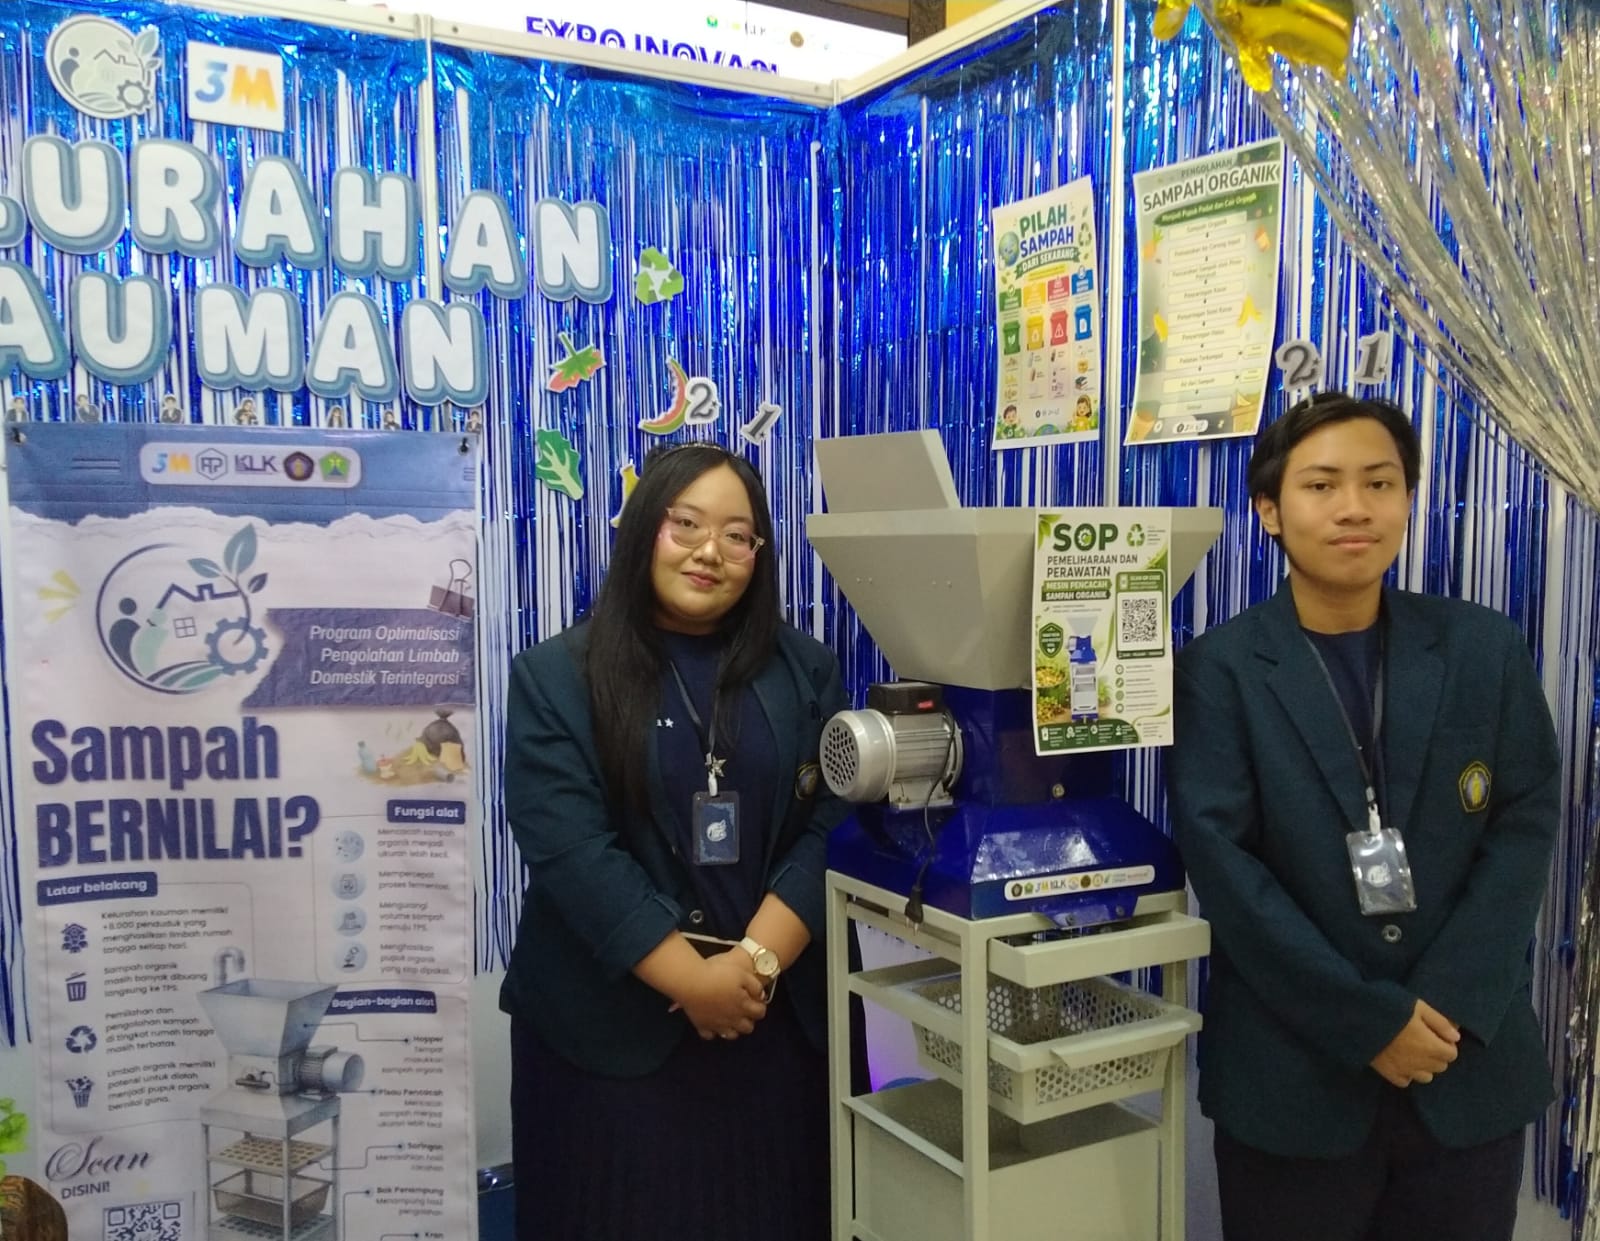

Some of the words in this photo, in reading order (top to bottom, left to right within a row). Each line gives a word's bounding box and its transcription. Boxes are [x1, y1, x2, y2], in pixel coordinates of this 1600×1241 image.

[194, 60, 278, 113] 3M
[1143, 179, 1204, 212] SAMPAH
[1208, 164, 1278, 192] ORGANIK
[0, 135, 613, 304] URAHAN
[1020, 203, 1067, 239] PILAH
[1020, 225, 1075, 258] SAMPAH
[1022, 257, 1039, 271] DARI
[1040, 248, 1075, 261] SEKARANG
[235, 454, 278, 473] KLK
[1052, 523, 1119, 552] SOP
[1047, 554, 1118, 566] PEMELIHARAAN
[1119, 553, 1138, 564] DAN
[1047, 566, 1111, 578] PERAWATAN
[1045, 592, 1074, 601] SAMPAH
[309, 625, 371, 643] Program
[375, 625, 460, 643] Optimalisasi
[320, 648, 404, 665] Pengolahan
[408, 648, 460, 663] Limbah
[310, 670, 377, 685] Domestik
[380, 670, 460, 688] Terintegrasi
[31, 716, 279, 790] Sampah
[394, 806, 435, 819] Fungsi
[436, 807, 460, 818] alat
[36, 795, 320, 868] BERNILAI?
[46, 884, 82, 897] Latar
[83, 879, 148, 893] belakang
[183, 919, 207, 929] yang
[202, 929, 233, 937] rumah
[103, 944, 137, 954] tangga
[139, 942, 167, 952] setiap
[104, 963, 143, 974] Sampah
[144, 962, 178, 972] organik
[104, 976, 133, 986] masih
[135, 973, 168, 983] banyak
[170, 972, 208, 982] dibuang
[156, 1007, 174, 1015] dan
[331, 996, 414, 1010] Bagian-bagian
[415, 998, 435, 1007] alat
[105, 1019, 161, 1032] pengolahan
[116, 1030, 149, 1041] tingkat
[151, 1029, 181, 1037] rumah
[182, 1028, 215, 1037] tangga
[143, 1062, 177, 1072] organik
[107, 1077, 141, 1090] potensi
[143, 1073, 169, 1082] untuk
[107, 1086, 145, 1099] menjadi
[147, 1084, 176, 1095] pupuk
[178, 1083, 211, 1092] organik
[45, 1136, 149, 1181] Scan
[61, 1181, 111, 1200] DISINI!
